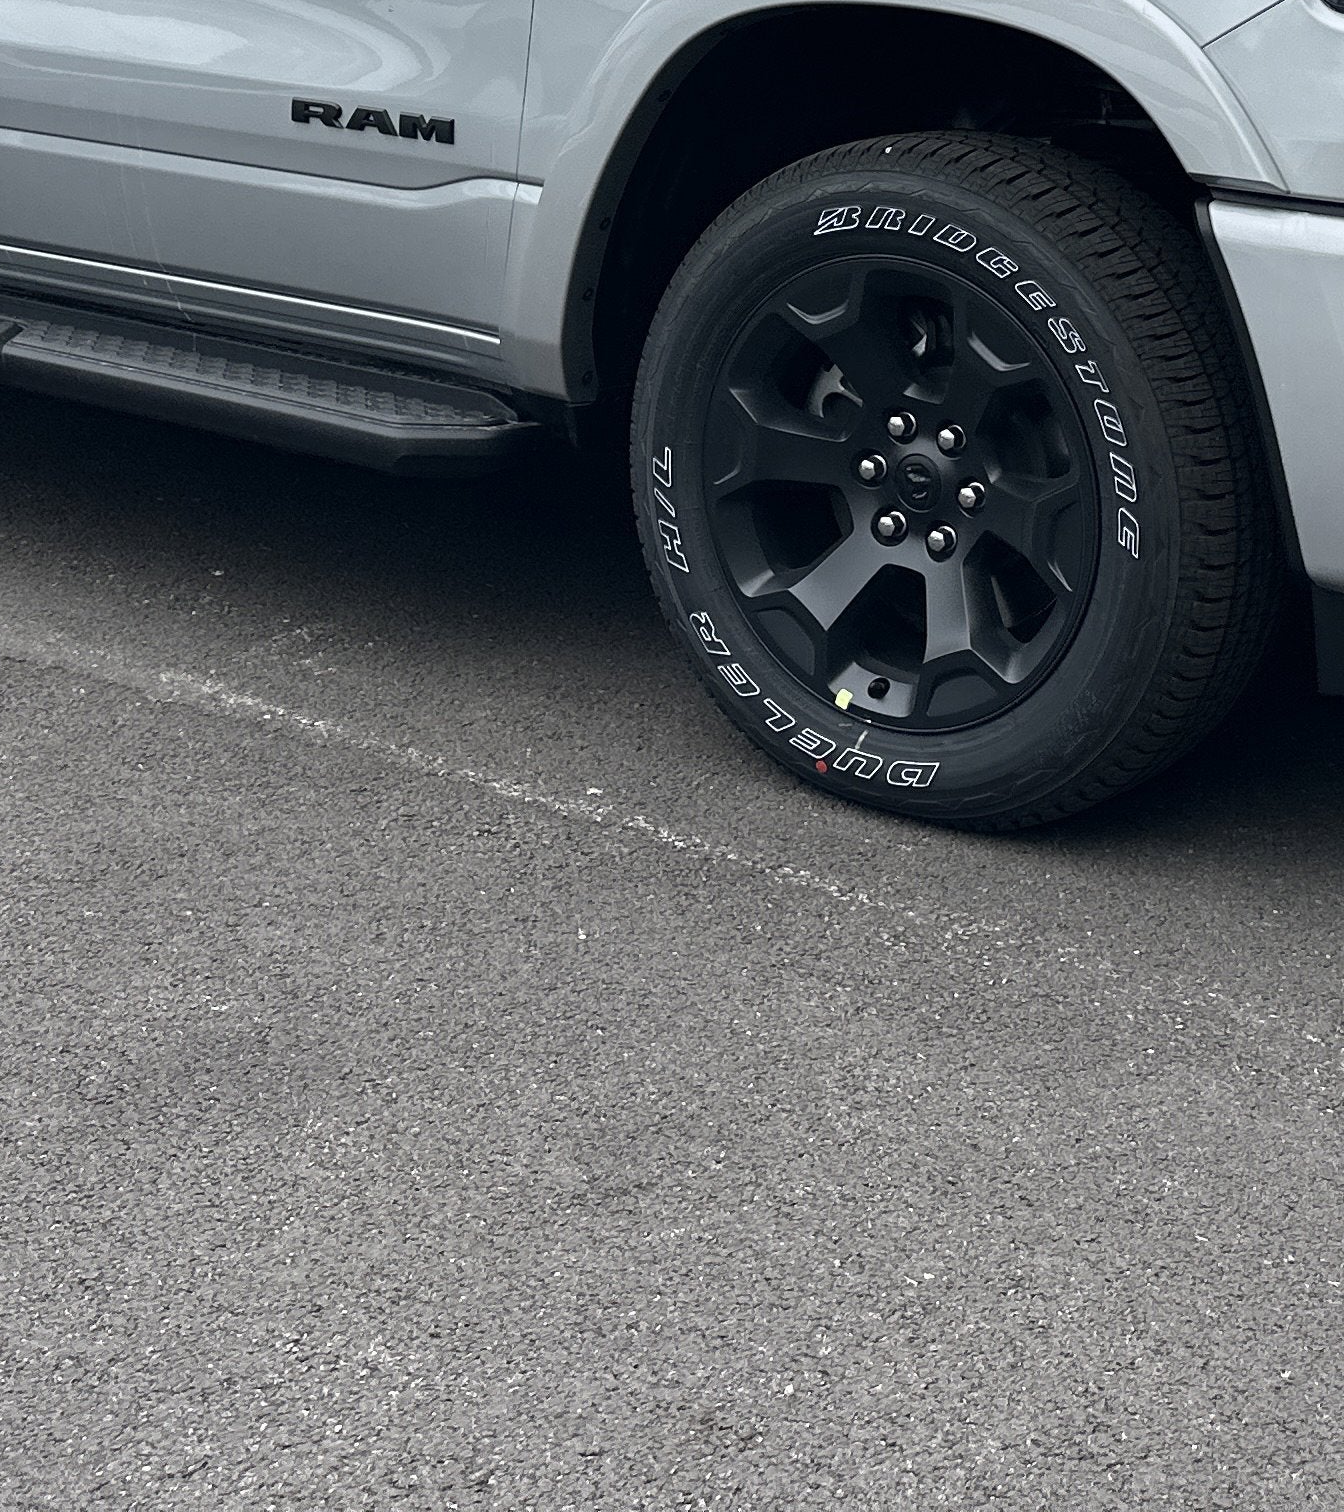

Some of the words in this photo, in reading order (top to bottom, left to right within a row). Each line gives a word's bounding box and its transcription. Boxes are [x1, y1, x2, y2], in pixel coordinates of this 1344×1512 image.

[291, 96, 455, 145] RAM
[813, 205, 1140, 559] BRIDGESTONE
[652, 446, 690, 573] H/L
[689, 611, 941, 788] DUELER
